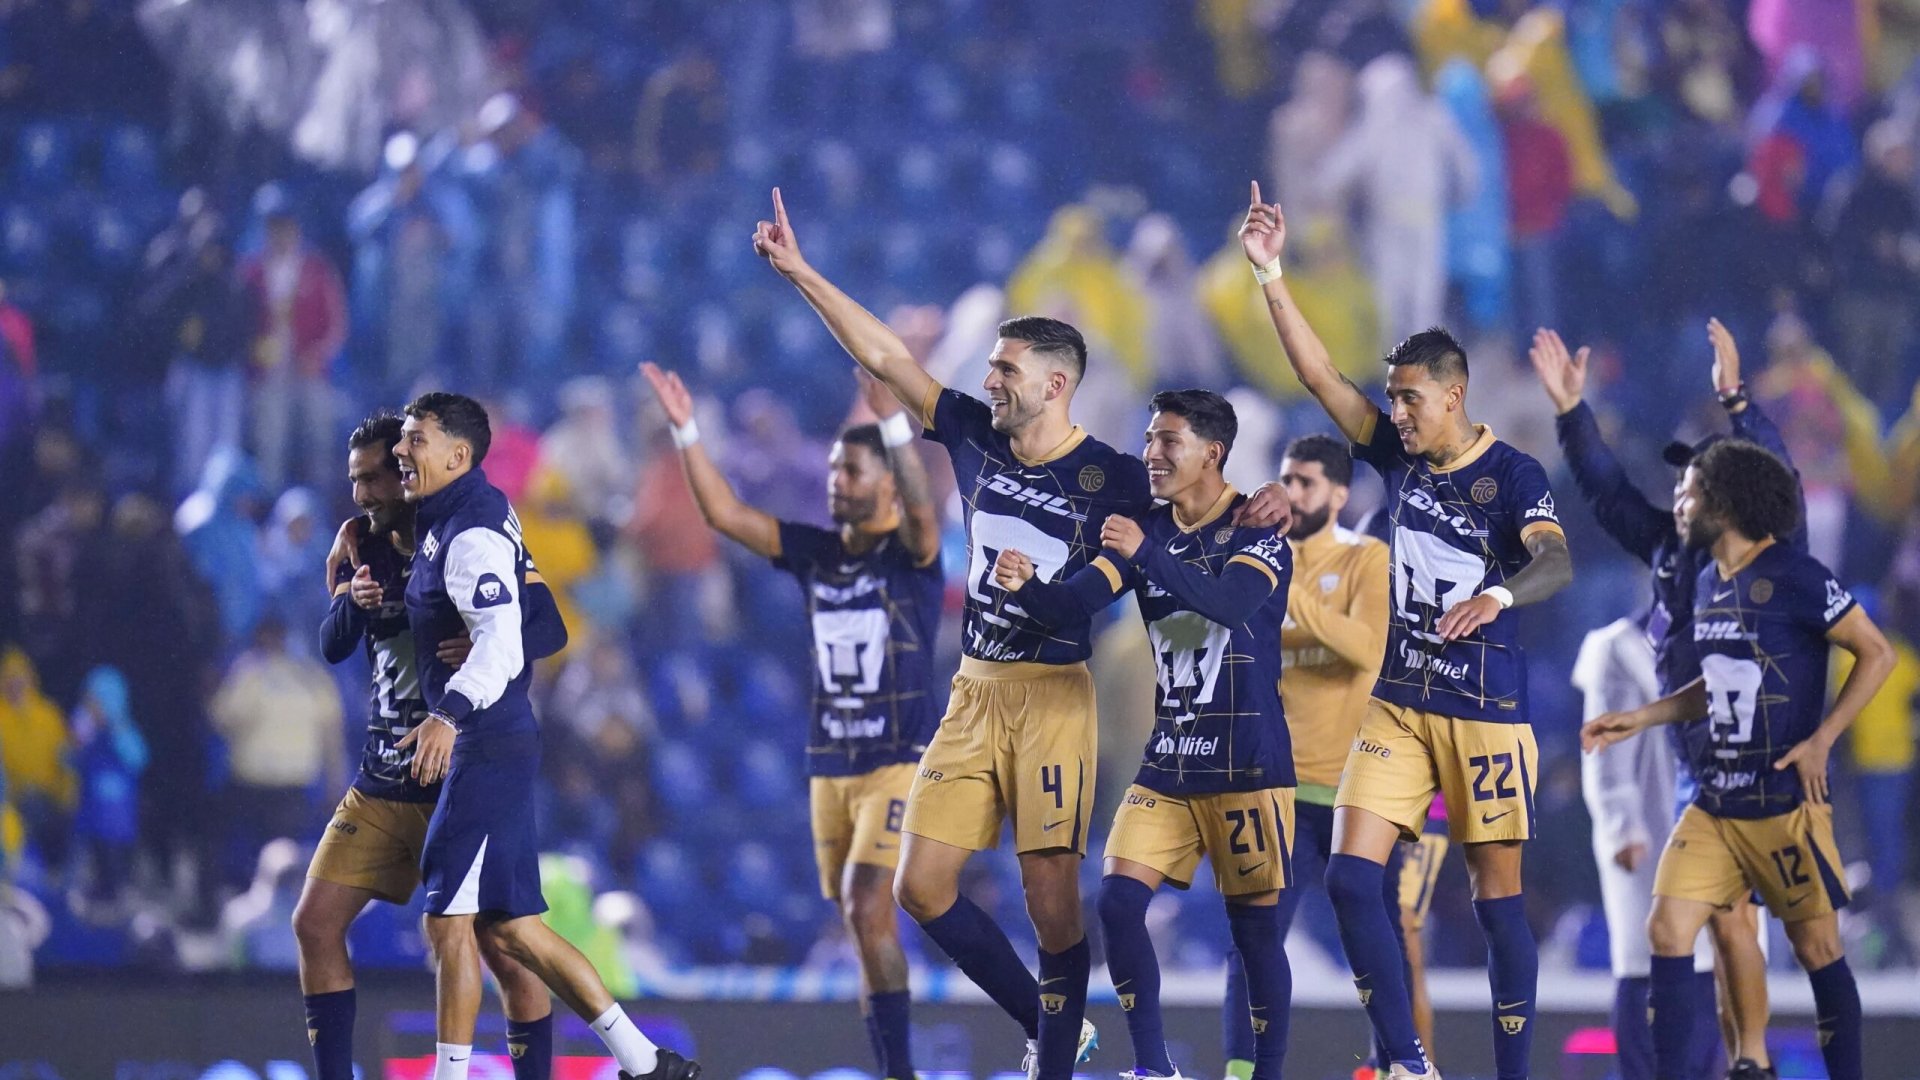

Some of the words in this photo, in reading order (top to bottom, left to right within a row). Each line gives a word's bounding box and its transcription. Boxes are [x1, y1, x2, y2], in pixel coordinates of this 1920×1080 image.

[986, 473, 1071, 516] DHL
[1041, 764, 1063, 809] 4
[1469, 752, 1517, 802] 22
[1225, 808, 1265, 855] 21
[1771, 845, 1810, 889] 12
